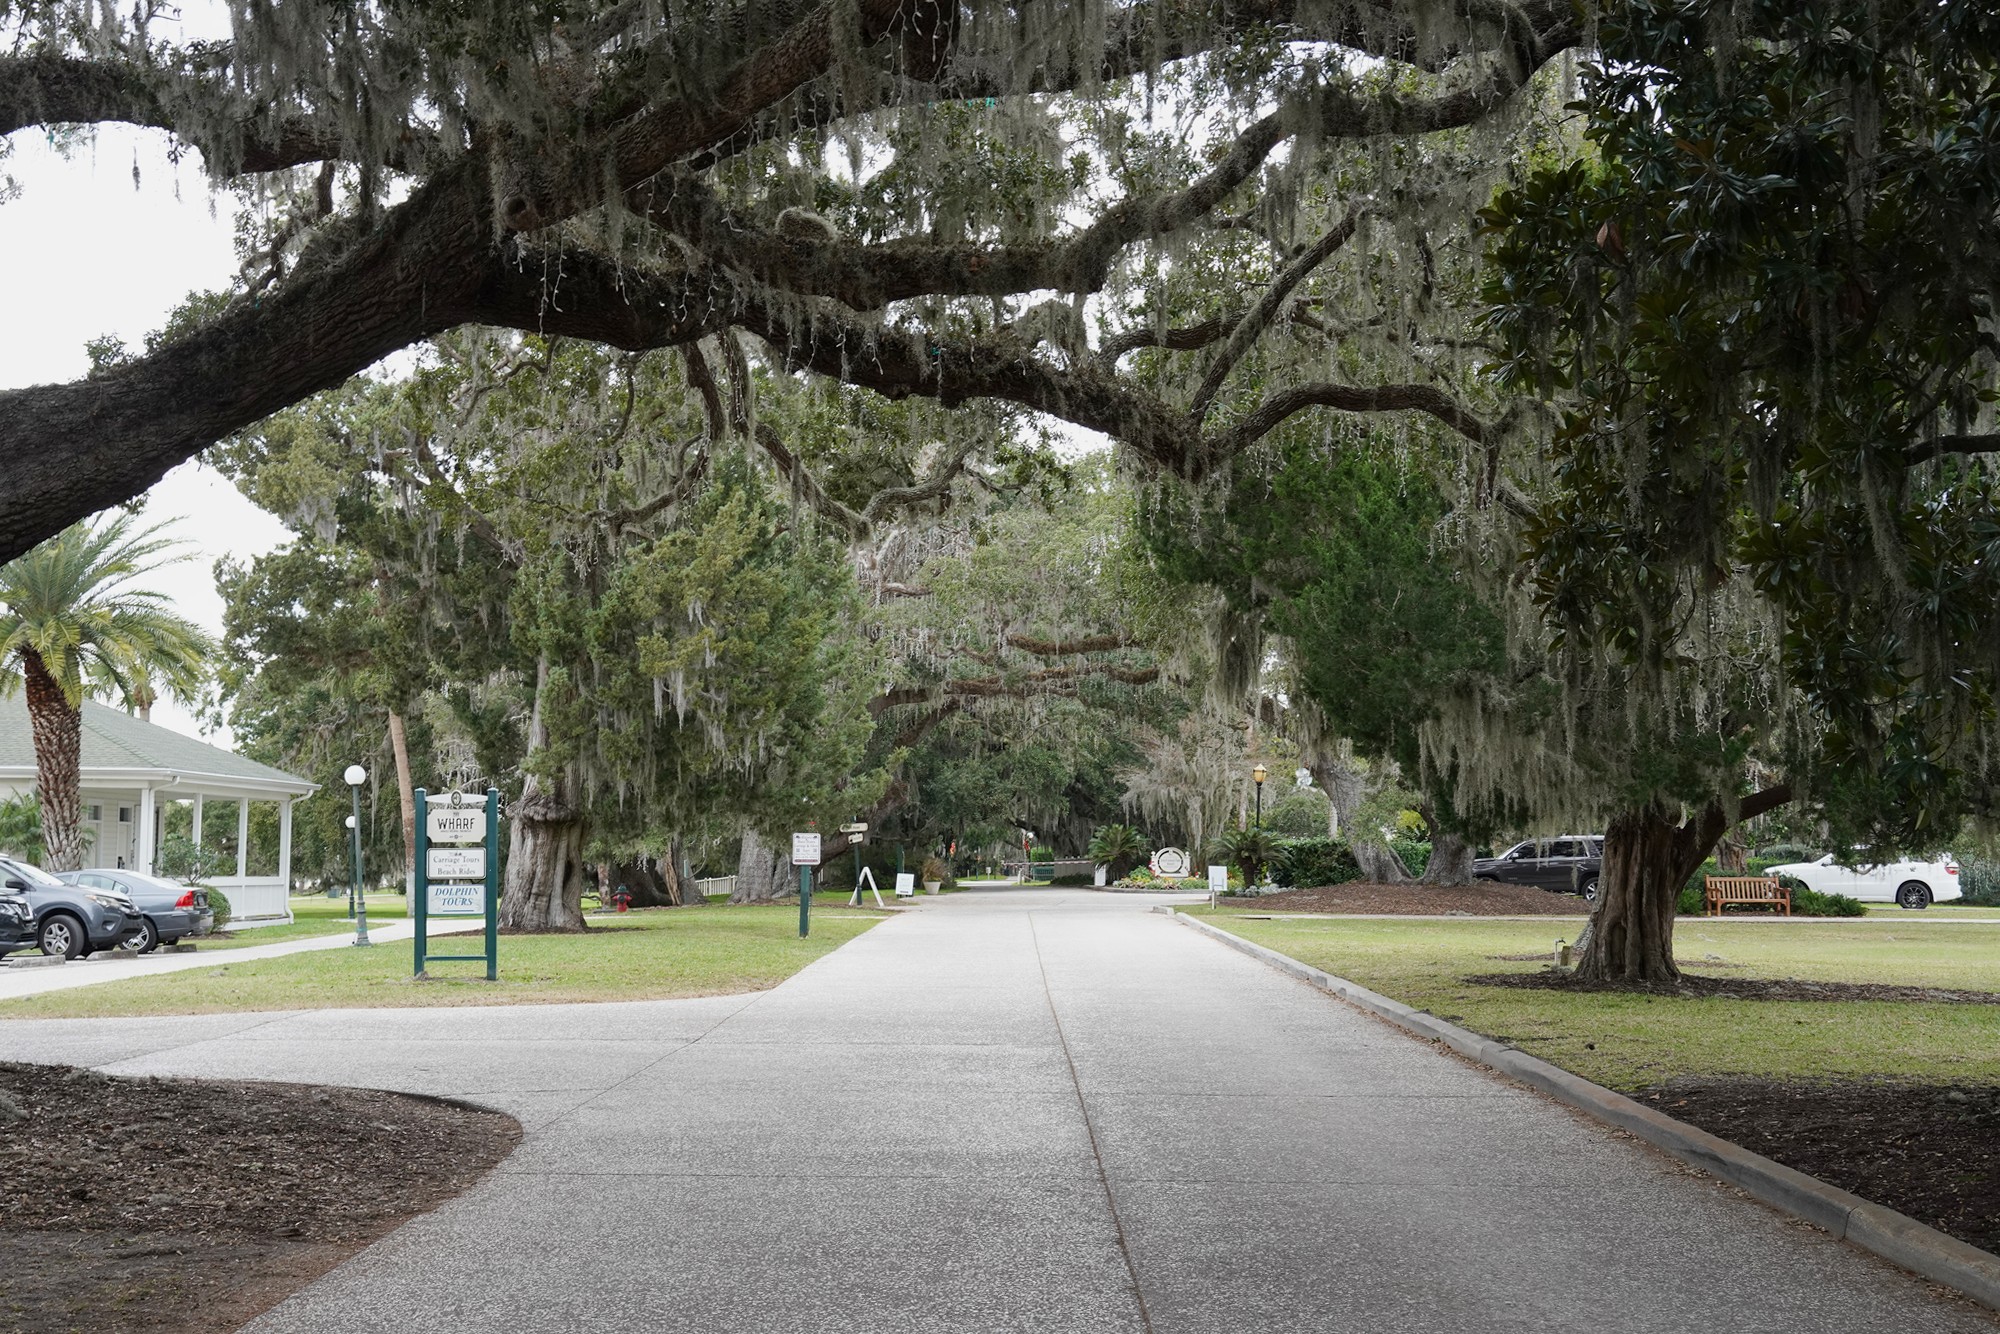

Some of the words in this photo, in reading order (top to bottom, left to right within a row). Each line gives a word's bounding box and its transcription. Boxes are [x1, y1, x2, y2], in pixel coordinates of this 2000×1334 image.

[437, 817, 475, 830] WHARF
[433, 856, 460, 864] Carriage
[435, 887, 479, 896] DOLPHIN
[442, 898, 473, 906] TOURS
